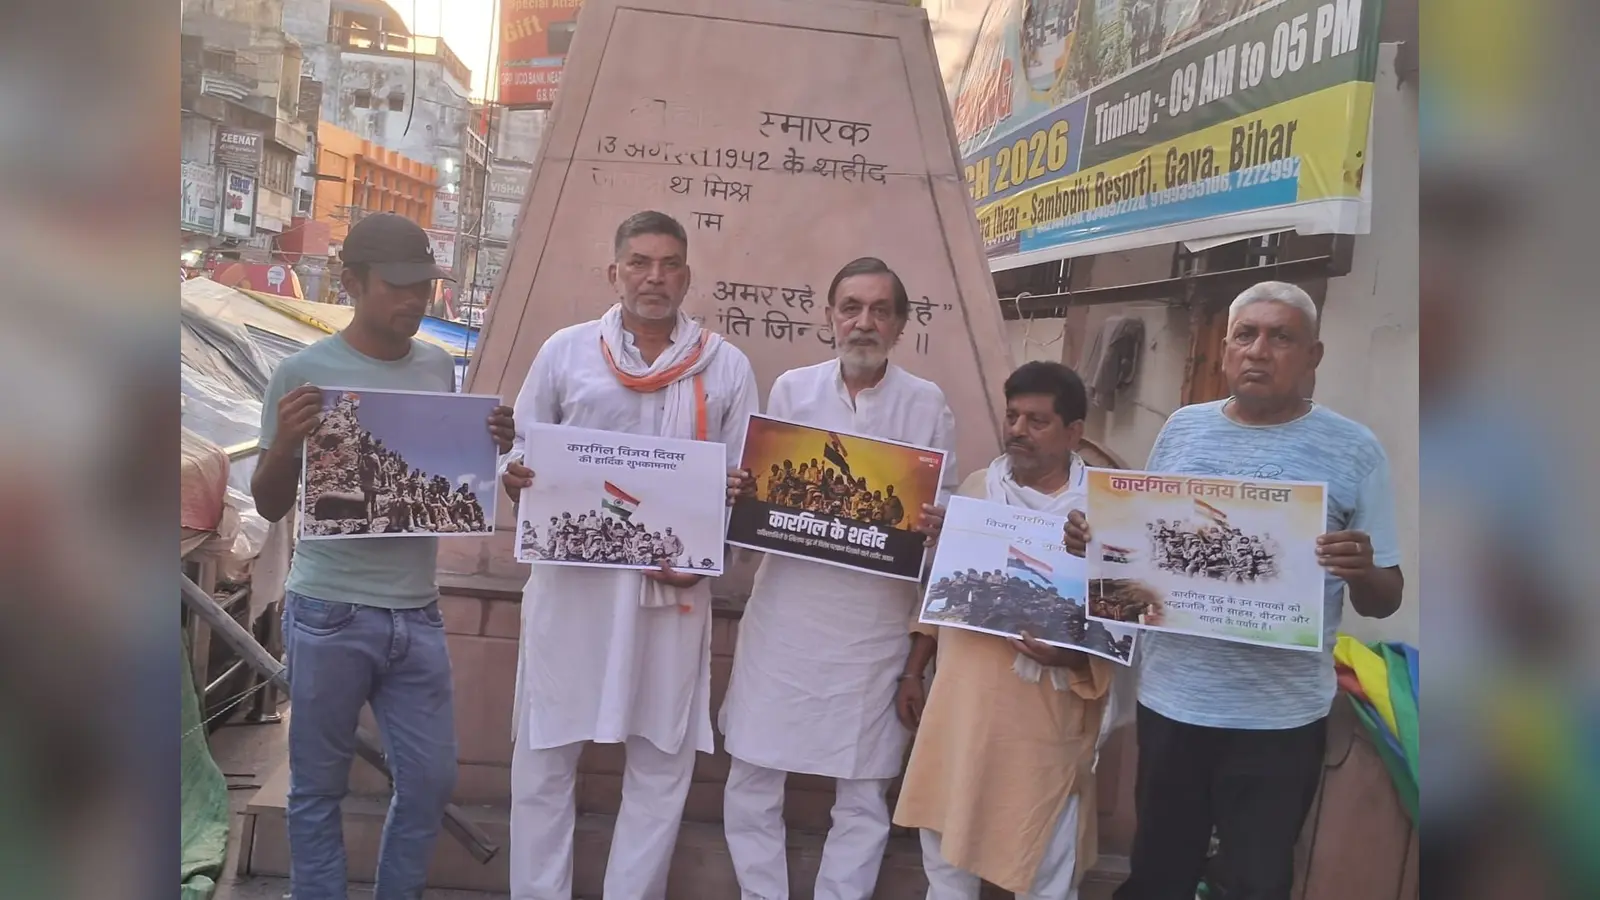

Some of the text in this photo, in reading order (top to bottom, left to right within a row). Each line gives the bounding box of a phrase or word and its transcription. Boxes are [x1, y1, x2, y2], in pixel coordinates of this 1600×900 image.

[506, 15, 543, 43] Gift
[1095, 90, 1151, 145] Timing
[1168, 62, 1198, 117] 09
[1198, 44, 1236, 106] AM
[1239, 41, 1266, 90] to
[1270, 13, 1308, 79] 05
[1312, 0, 1362, 64] PM
[221, 132, 257, 146] ZEENAT
[760, 111, 872, 147] स्मारक
[994, 120, 1070, 193] 2026
[1229, 119, 1298, 170] Bihar
[597, 136, 617, 154] 13
[714, 148, 771, 171] 1942
[783, 147, 805, 175] के
[812, 154, 888, 184] शहीद
[703, 173, 753, 202] मिश्र
[712, 280, 778, 307] अमर
[781, 284, 816, 313] रहे
[567, 443, 686, 461] कारगिल विजय दिवस
[578, 454, 677, 471] की हार्दिक शुभकामनाएं
[1111, 476, 1292, 503] कारगिल विजय दिवस
[769, 510, 889, 550] कारगिल के शहीद
[1015, 536, 1032, 546] 26
[1171, 590, 1206, 601] कारगिल
[1208, 594, 1224, 605] युद्ध
[1227, 595, 1236, 604] के
[1239, 598, 1251, 607] उन
[1287, 604, 1301, 613] को
[1211, 604, 1224, 613] जो
[1227, 607, 1256, 619] साहस,
[1259, 610, 1287, 622] वीरता
[1290, 613, 1311, 624] और
[1199, 614, 1223, 625] साहस
[1225, 616, 1234, 626] के
